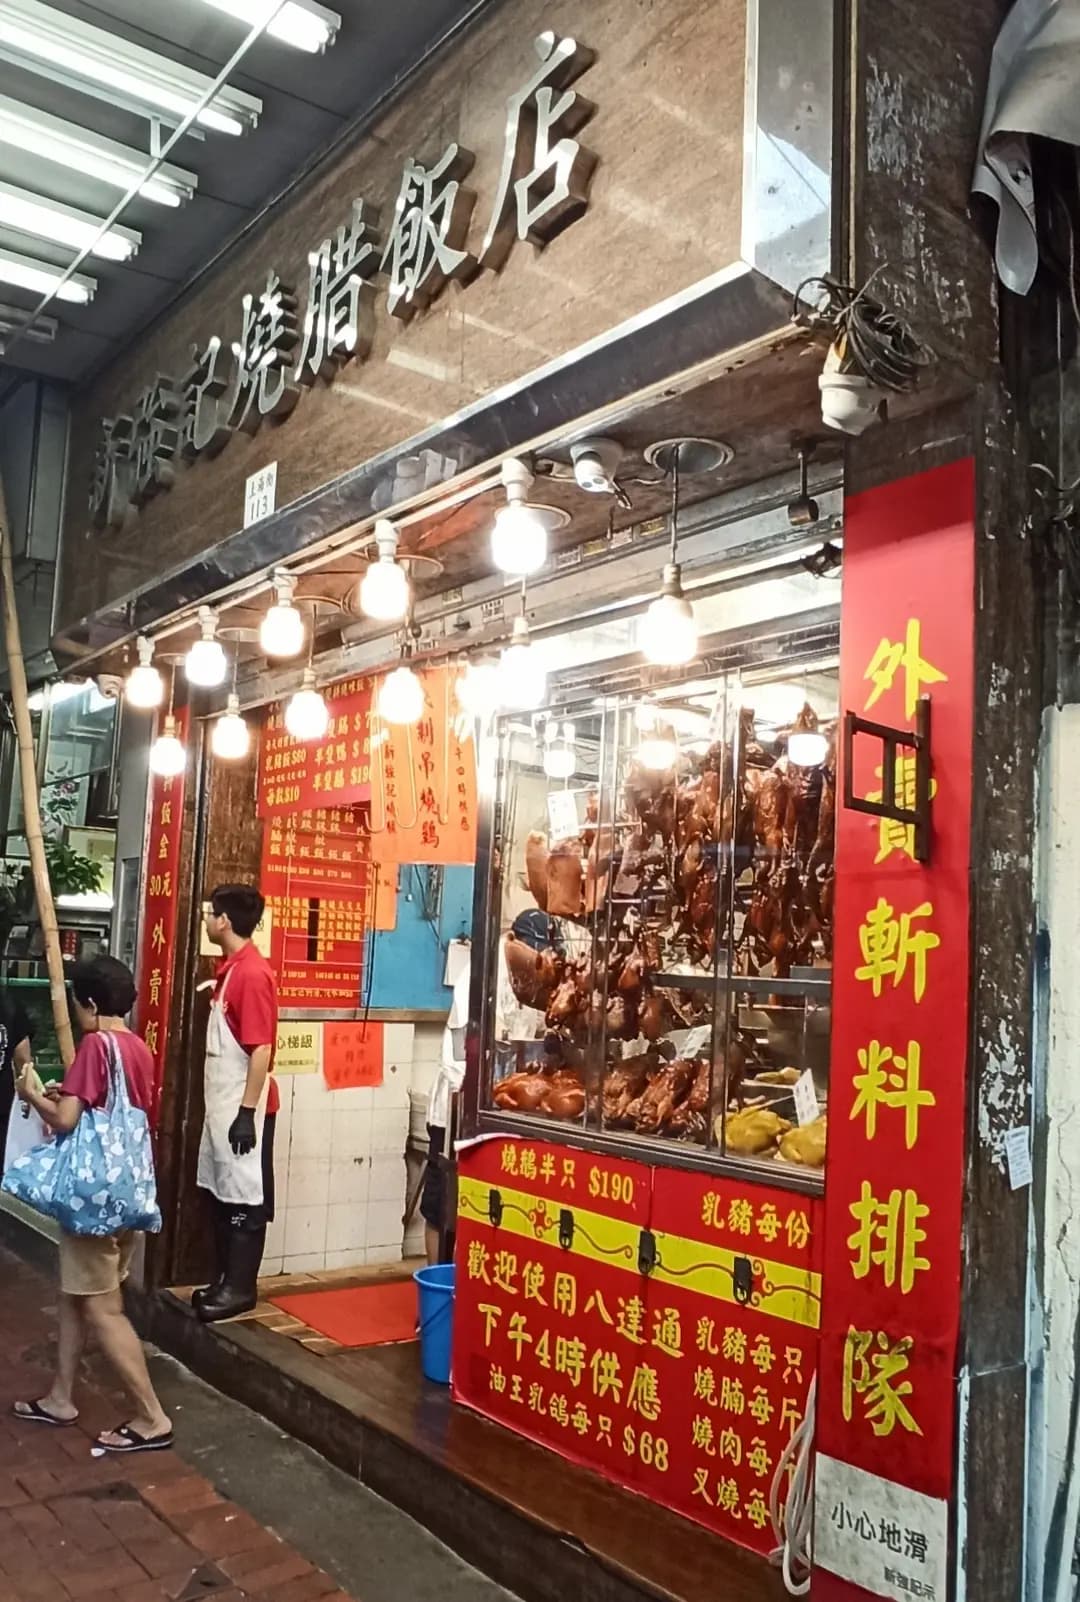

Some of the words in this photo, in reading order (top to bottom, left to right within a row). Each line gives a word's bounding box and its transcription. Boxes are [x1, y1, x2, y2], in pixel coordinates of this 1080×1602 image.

[588, 1165, 634, 1205] $190
[701, 1191, 811, 1249] 乳豬每份
[466, 1240, 685, 1358] 歡迎使用八達通
[477, 1302, 662, 1421] 下午4時供應
[695, 1315, 804, 1385] 乳豬每只
[622, 1423, 669, 1472] $68
[691, 1466, 788, 1530] 叉燒每
[831, 1501, 928, 1564] 小心地滑
